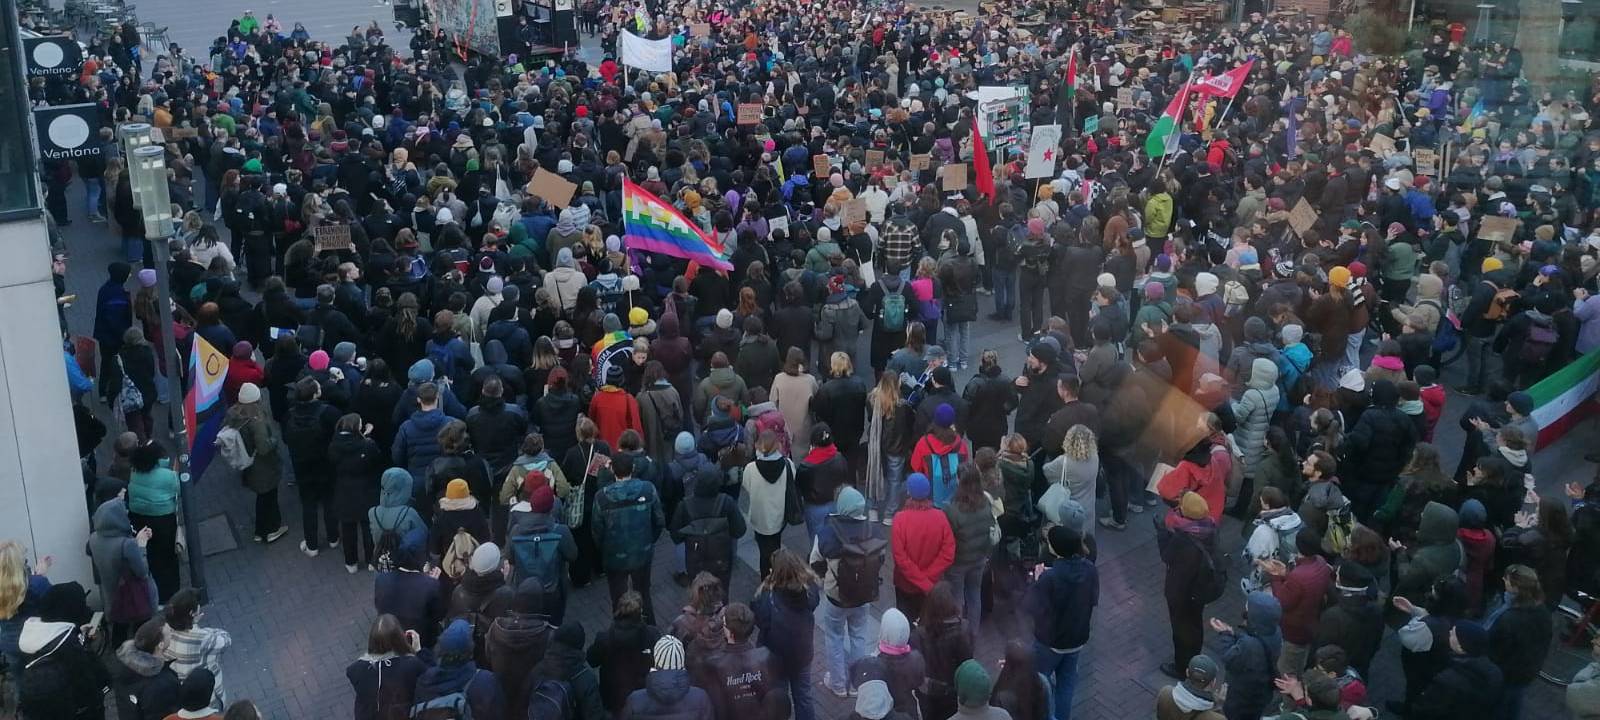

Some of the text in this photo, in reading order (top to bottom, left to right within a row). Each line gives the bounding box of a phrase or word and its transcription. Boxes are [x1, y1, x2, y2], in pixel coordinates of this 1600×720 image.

[30, 67, 71, 75] Ventana
[43, 147, 100, 159] Ventana
[727, 670, 762, 686] Hard Rock
